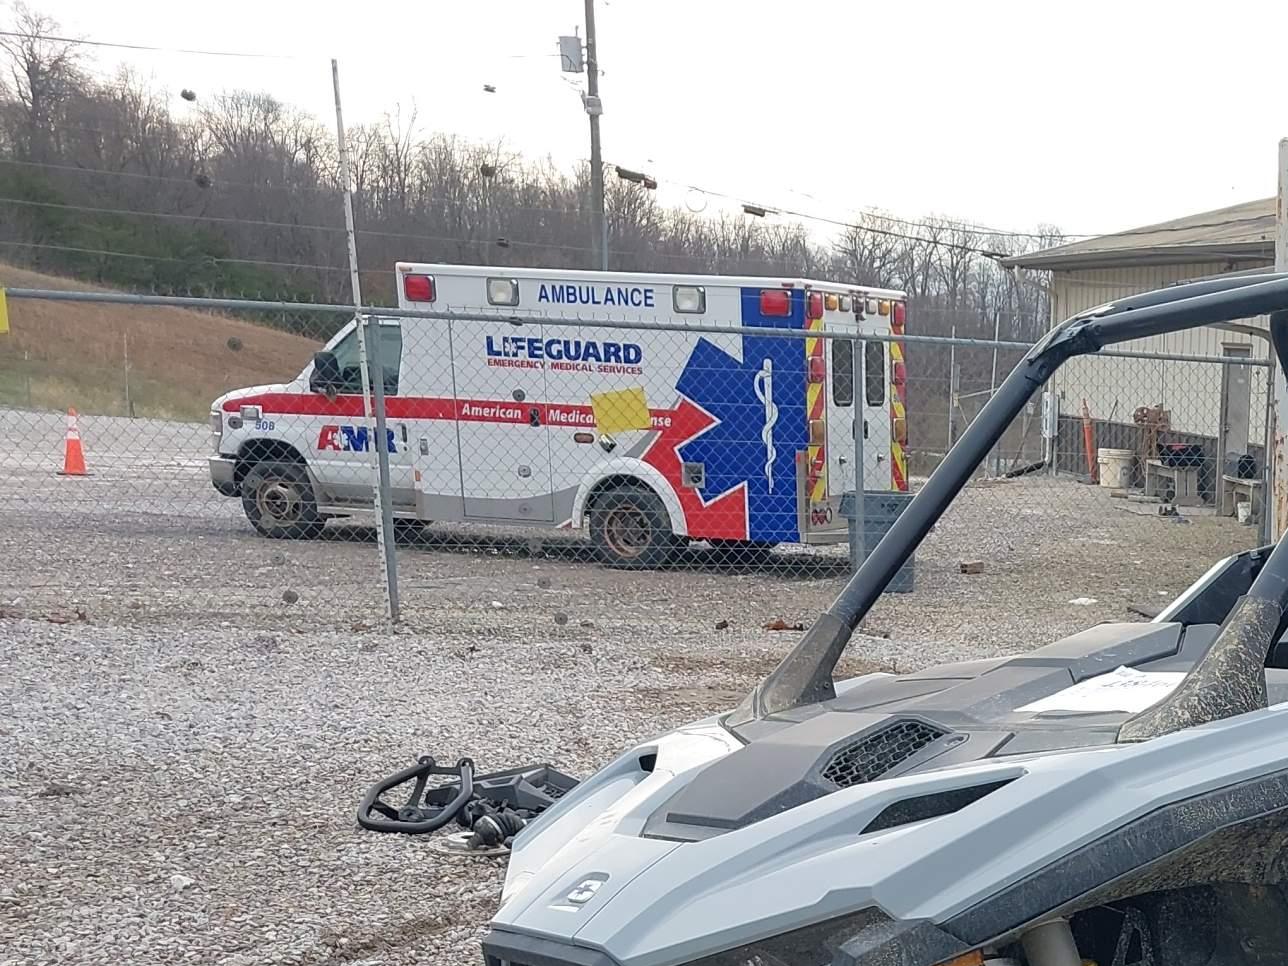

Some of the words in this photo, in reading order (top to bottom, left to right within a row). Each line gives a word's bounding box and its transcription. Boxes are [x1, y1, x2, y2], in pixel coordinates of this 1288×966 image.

[538, 283, 656, 309] AMBULANCE
[485, 335, 643, 365] LIFEGUARD
[487, 358, 546, 370] EMERGENCY
[549, 361, 594, 373] MEDICAL
[596, 364, 643, 375] SERVICES
[462, 403, 522, 420] American
